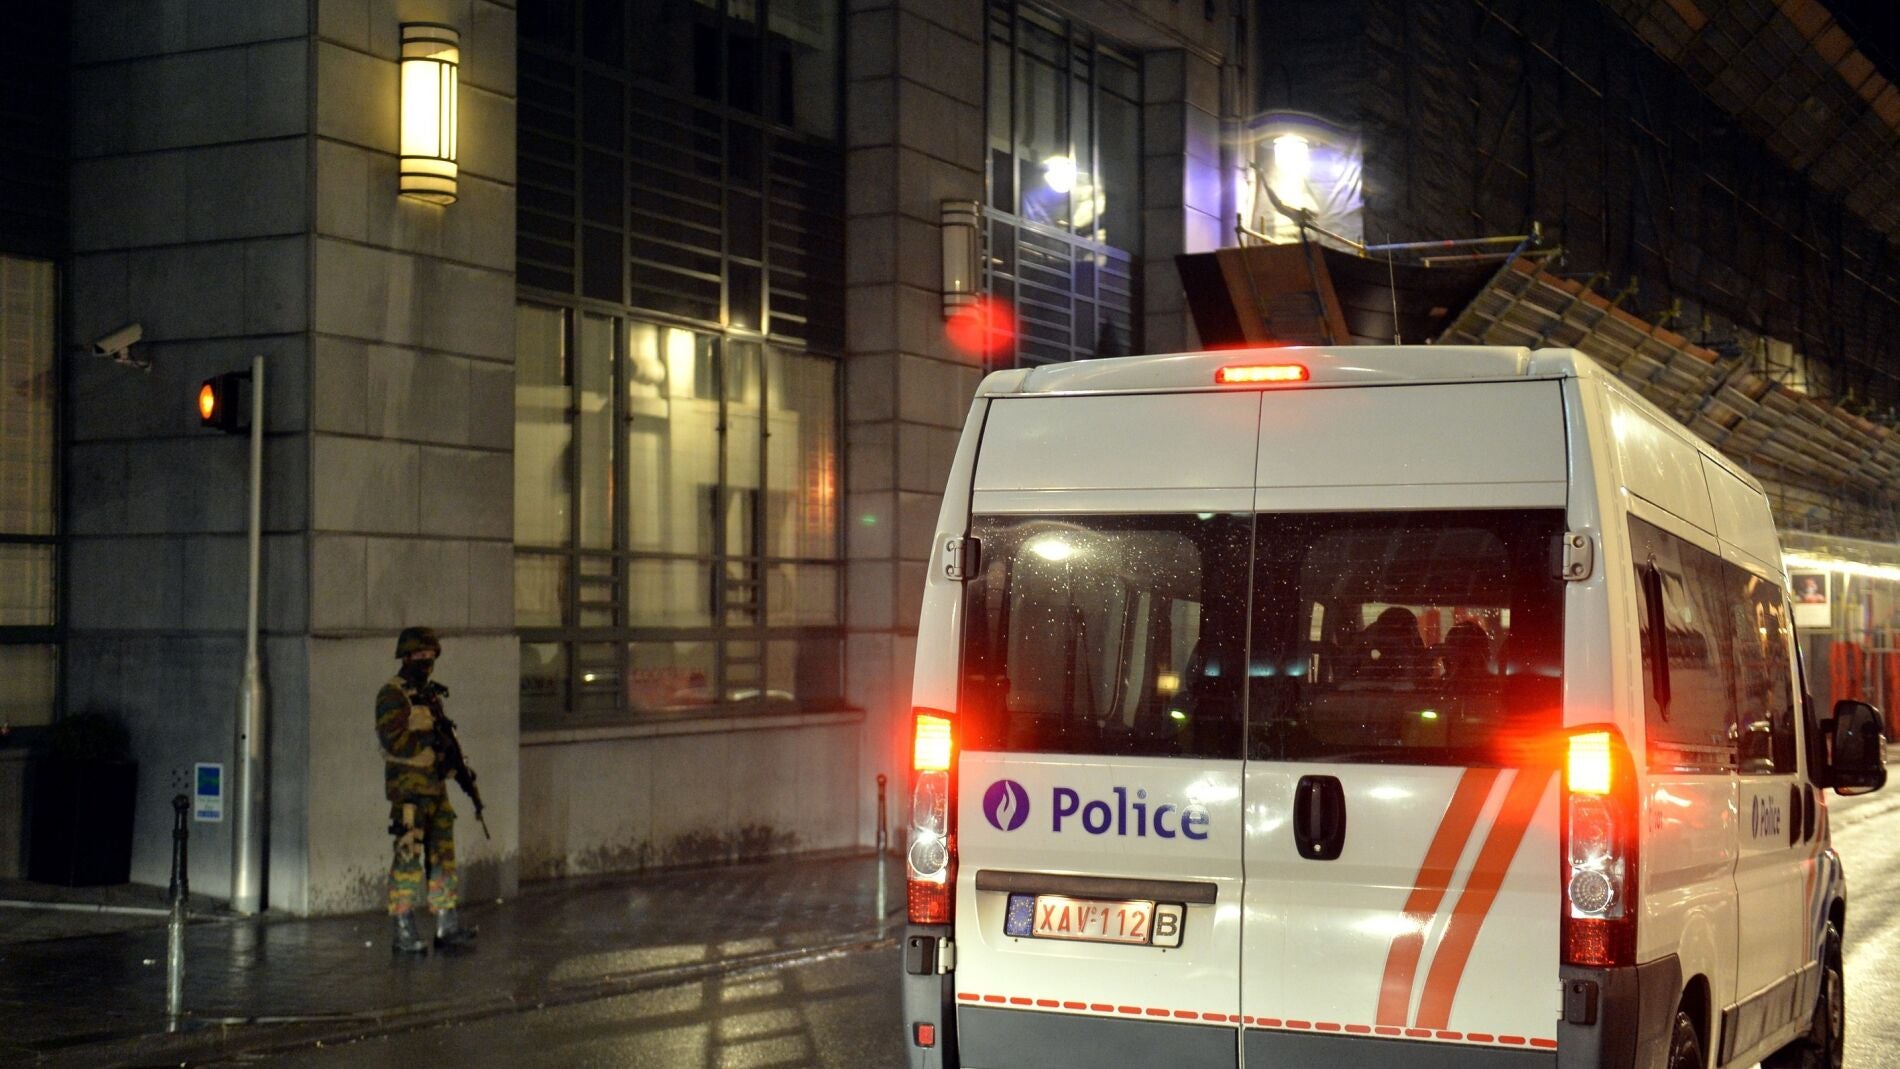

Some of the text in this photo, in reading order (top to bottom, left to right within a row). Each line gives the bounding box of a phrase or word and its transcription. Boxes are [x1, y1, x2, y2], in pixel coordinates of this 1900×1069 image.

[1052, 786, 1210, 840] Police
[1759, 795, 1780, 837] Police
[1156, 912, 1178, 937] B
